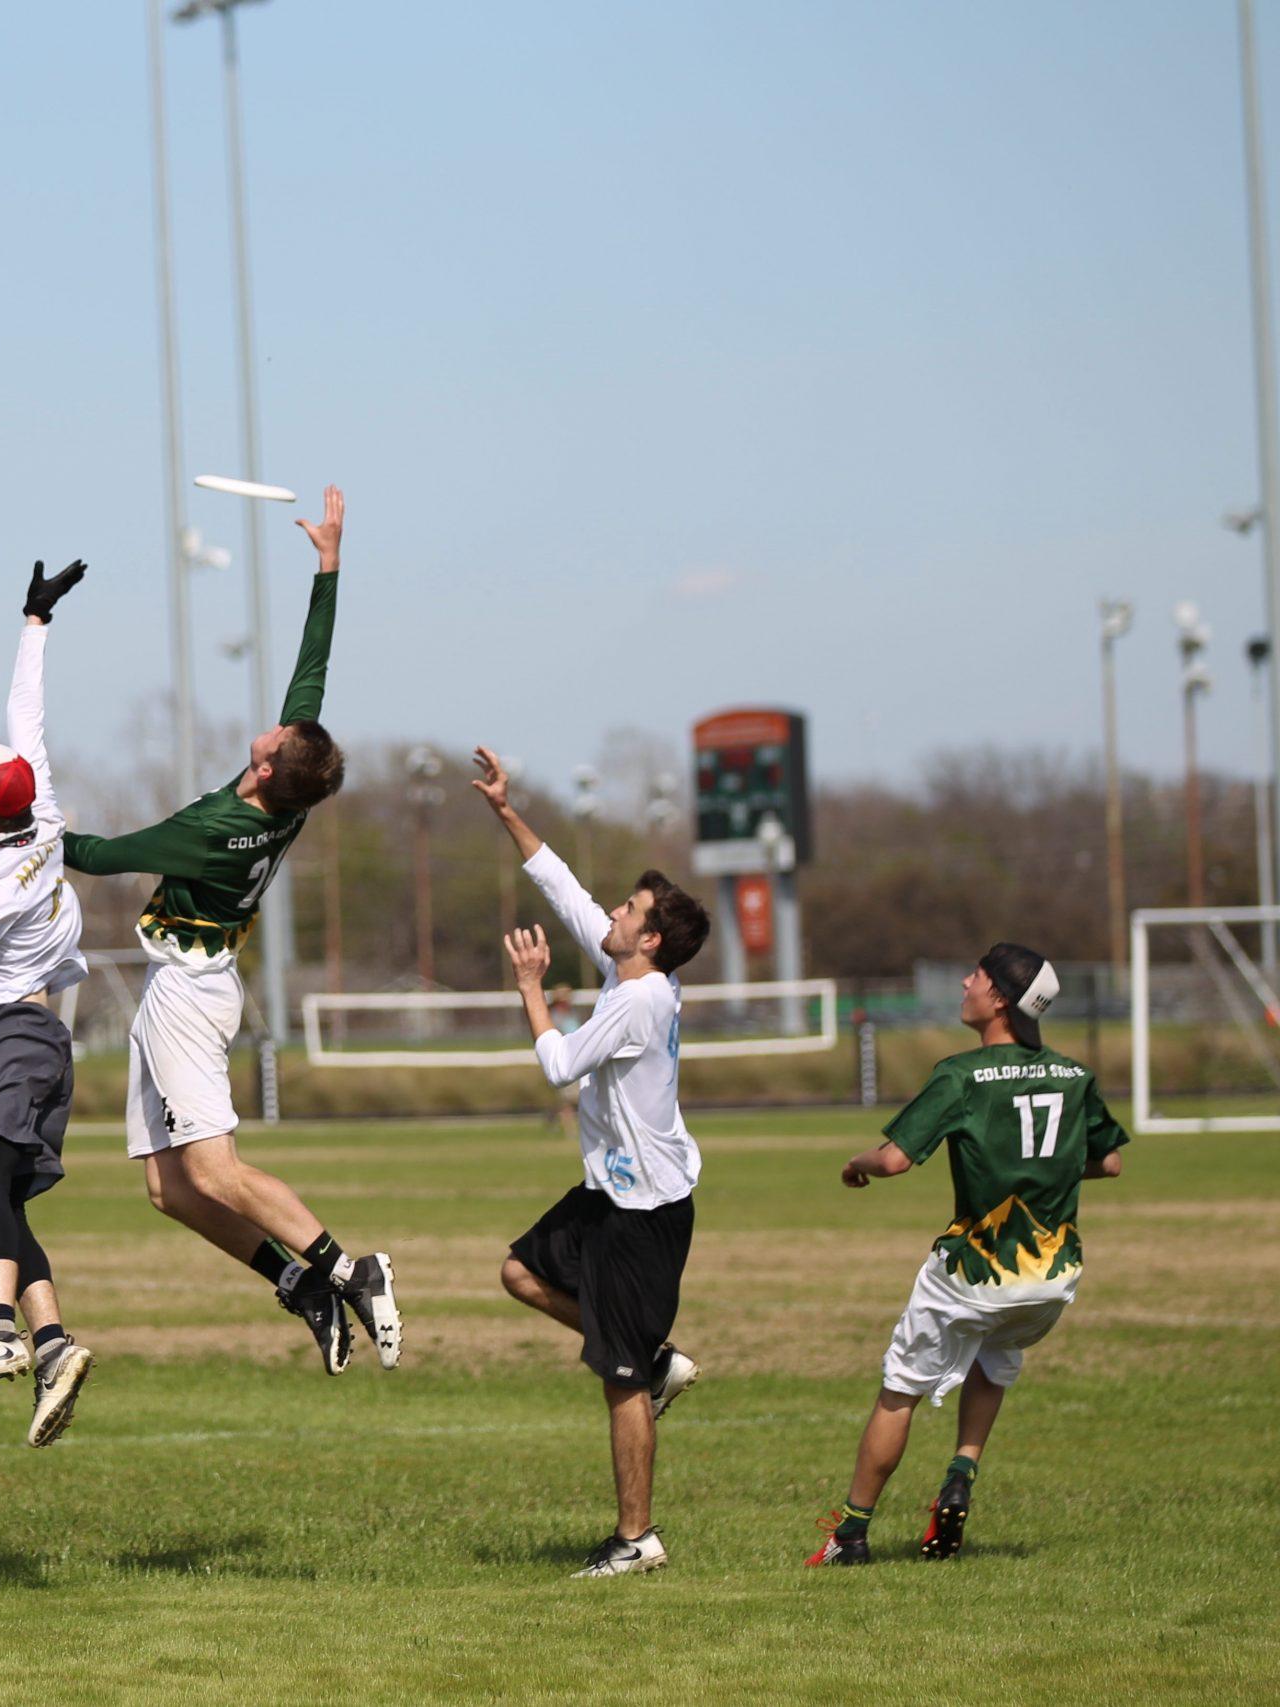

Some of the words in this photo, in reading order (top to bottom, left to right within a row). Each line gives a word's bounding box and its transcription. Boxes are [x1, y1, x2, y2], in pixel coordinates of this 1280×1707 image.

[973, 1065, 1046, 1083] COLORADO
[1049, 1063, 1086, 1079] STATE
[1012, 1092, 1064, 1159] 17
